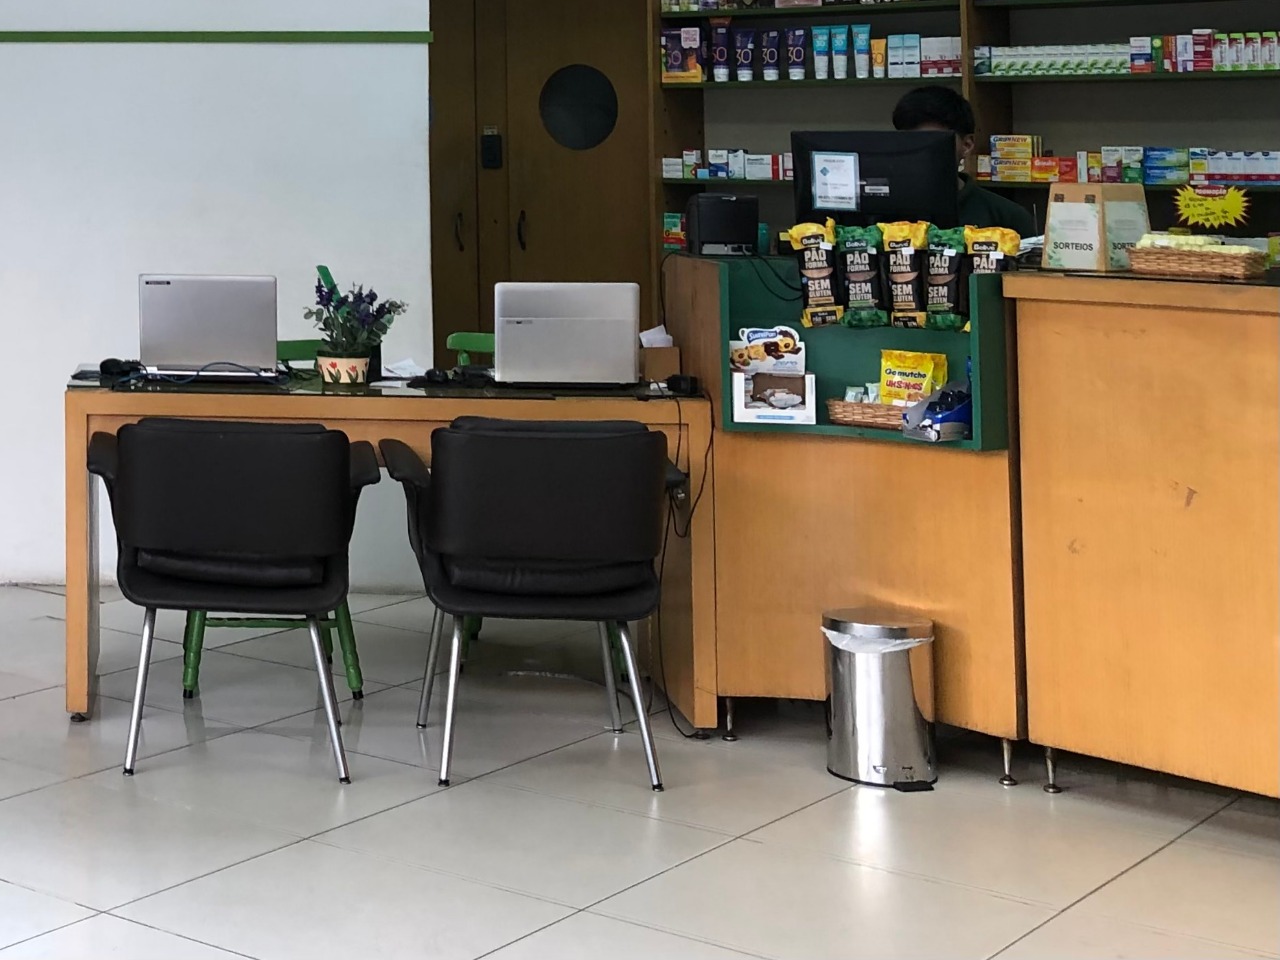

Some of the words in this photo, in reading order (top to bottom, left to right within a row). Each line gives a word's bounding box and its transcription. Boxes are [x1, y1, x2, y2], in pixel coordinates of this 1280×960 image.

[762, 47, 778, 65] 30
[788, 46, 805, 64] 30
[1053, 241, 1094, 251] SORTEIOS
[804, 248, 826, 262] PÃO
[846, 251, 869, 265] PÃO
[889, 251, 910, 266] PÃO
[929, 253, 949, 268] PÃO
[805, 260, 828, 269] FORMA
[847, 264, 870, 272] FORMA
[889, 264, 911, 273] FORMA
[972, 255, 996, 270] PÃO
[808, 279, 831, 291] SEM
[849, 282, 872, 294] SEM
[891, 283, 913, 295] SEM
[928, 286, 948, 298] SEM
